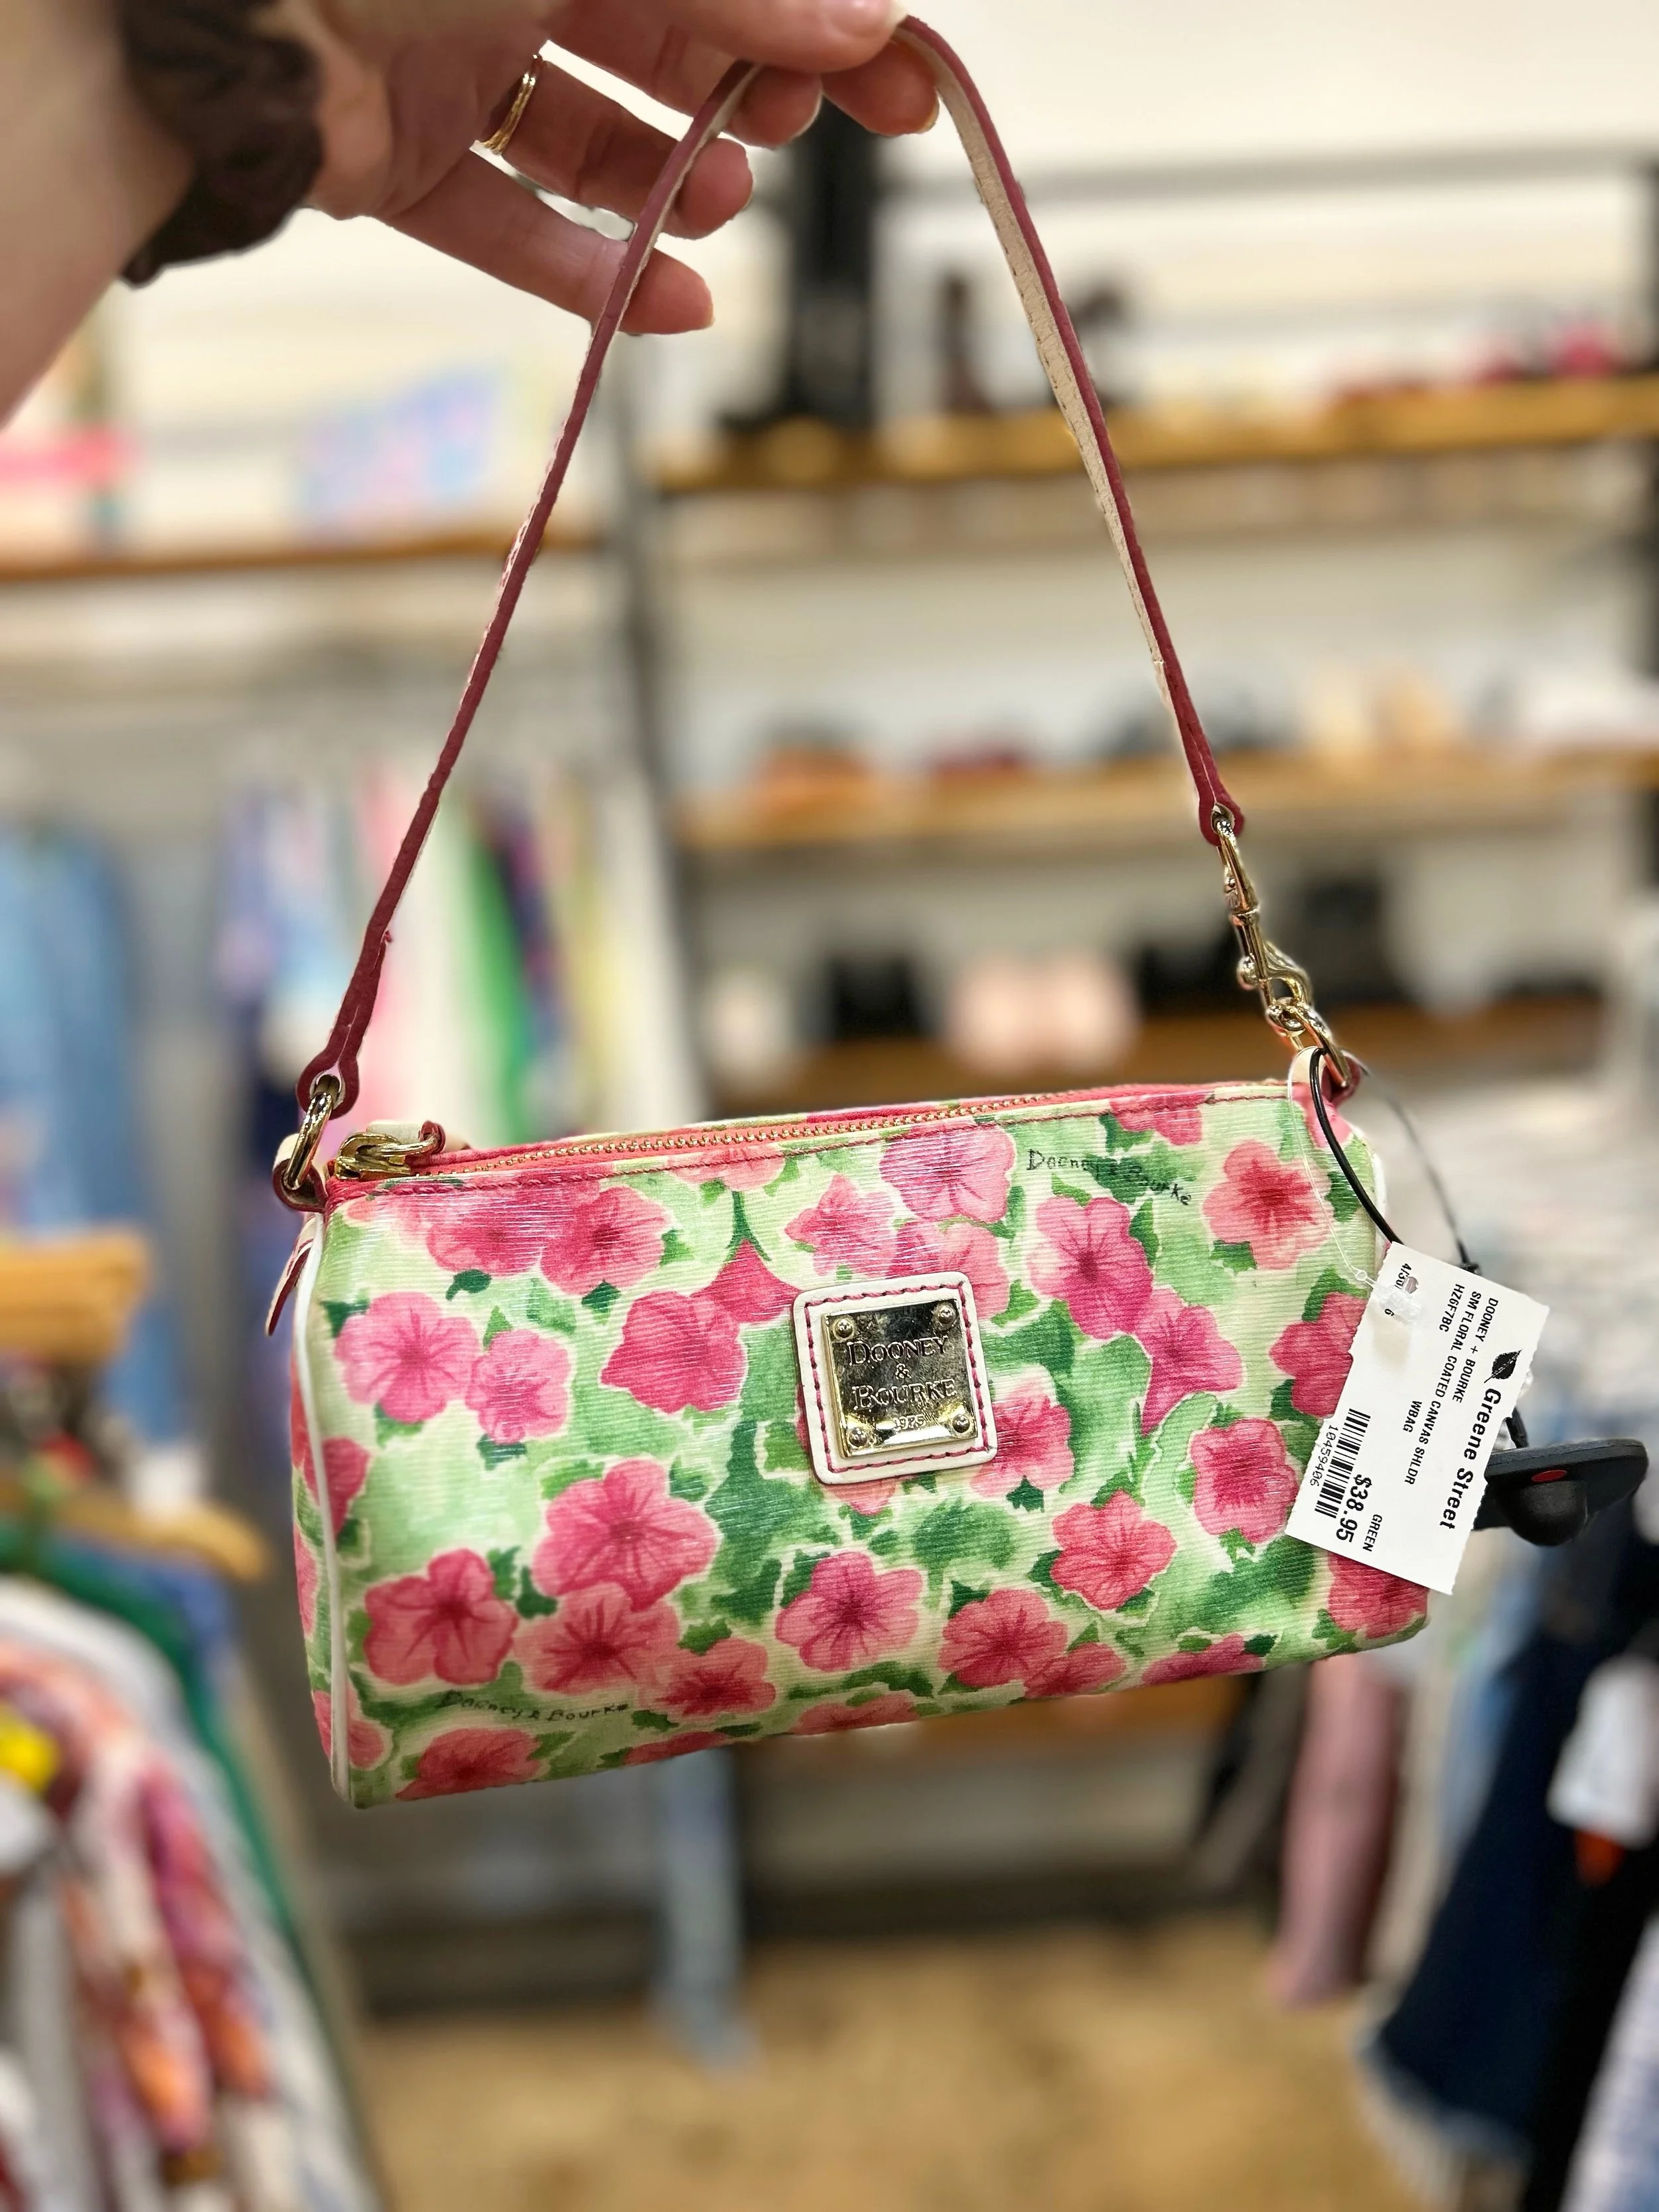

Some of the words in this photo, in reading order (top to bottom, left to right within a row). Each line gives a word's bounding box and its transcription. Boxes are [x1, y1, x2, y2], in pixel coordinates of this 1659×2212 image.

[1439, 1284, 1465, 1332] HZ6F7BC
[1467, 1291, 1481, 1309] SM
[1475, 1297, 1498, 1342] DOONEY
[846, 1335, 948, 1366] DOONEY
[1451, 1311, 1475, 1350] FLORAL
[895, 1363, 910, 1380] &
[1435, 1356, 1457, 1398] COATED
[1452, 1359, 1476, 1403] BOURKE
[852, 1378, 957, 1411] BOURKE
[893, 1414, 926, 1431] 1975
[1403, 1401, 1422, 1432] WBAG
[1419, 1401, 1441, 1444] CANVAS
[1464, 1388, 1501, 1460] Greene
[1310, 1425, 1338, 1486] 10459406
[1404, 1447, 1425, 1485] SHLDR
[1336, 1474, 1372, 1542] $38.95
[1439, 1468, 1473, 1529] Street
[1362, 1514, 1382, 1552] GREEN
